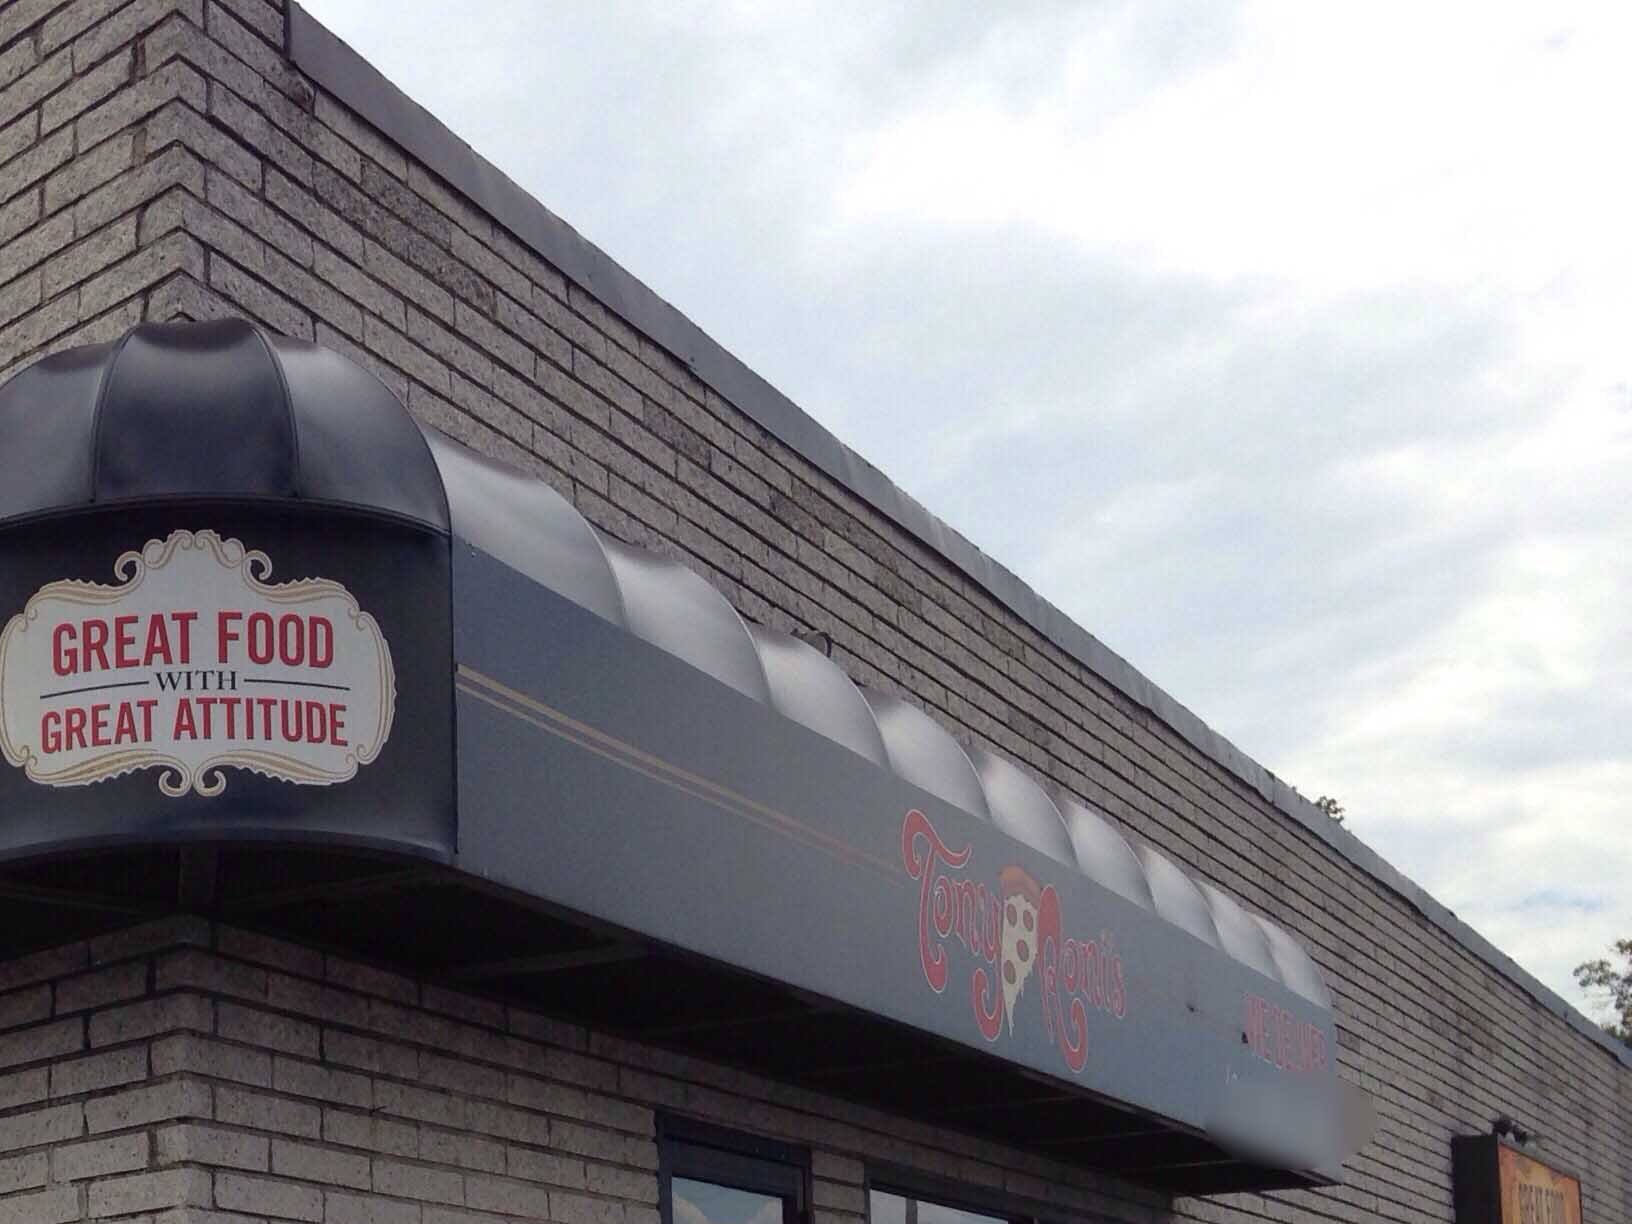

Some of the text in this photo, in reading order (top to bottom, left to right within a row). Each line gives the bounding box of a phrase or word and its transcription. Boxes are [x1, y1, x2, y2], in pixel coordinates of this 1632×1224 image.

[52, 611, 335, 677] GREAT FOOD
[154, 671, 239, 692] WITH
[41, 697, 349, 754] GREAT ATTITUDE
[902, 809, 1126, 1073] Tony Roni's
